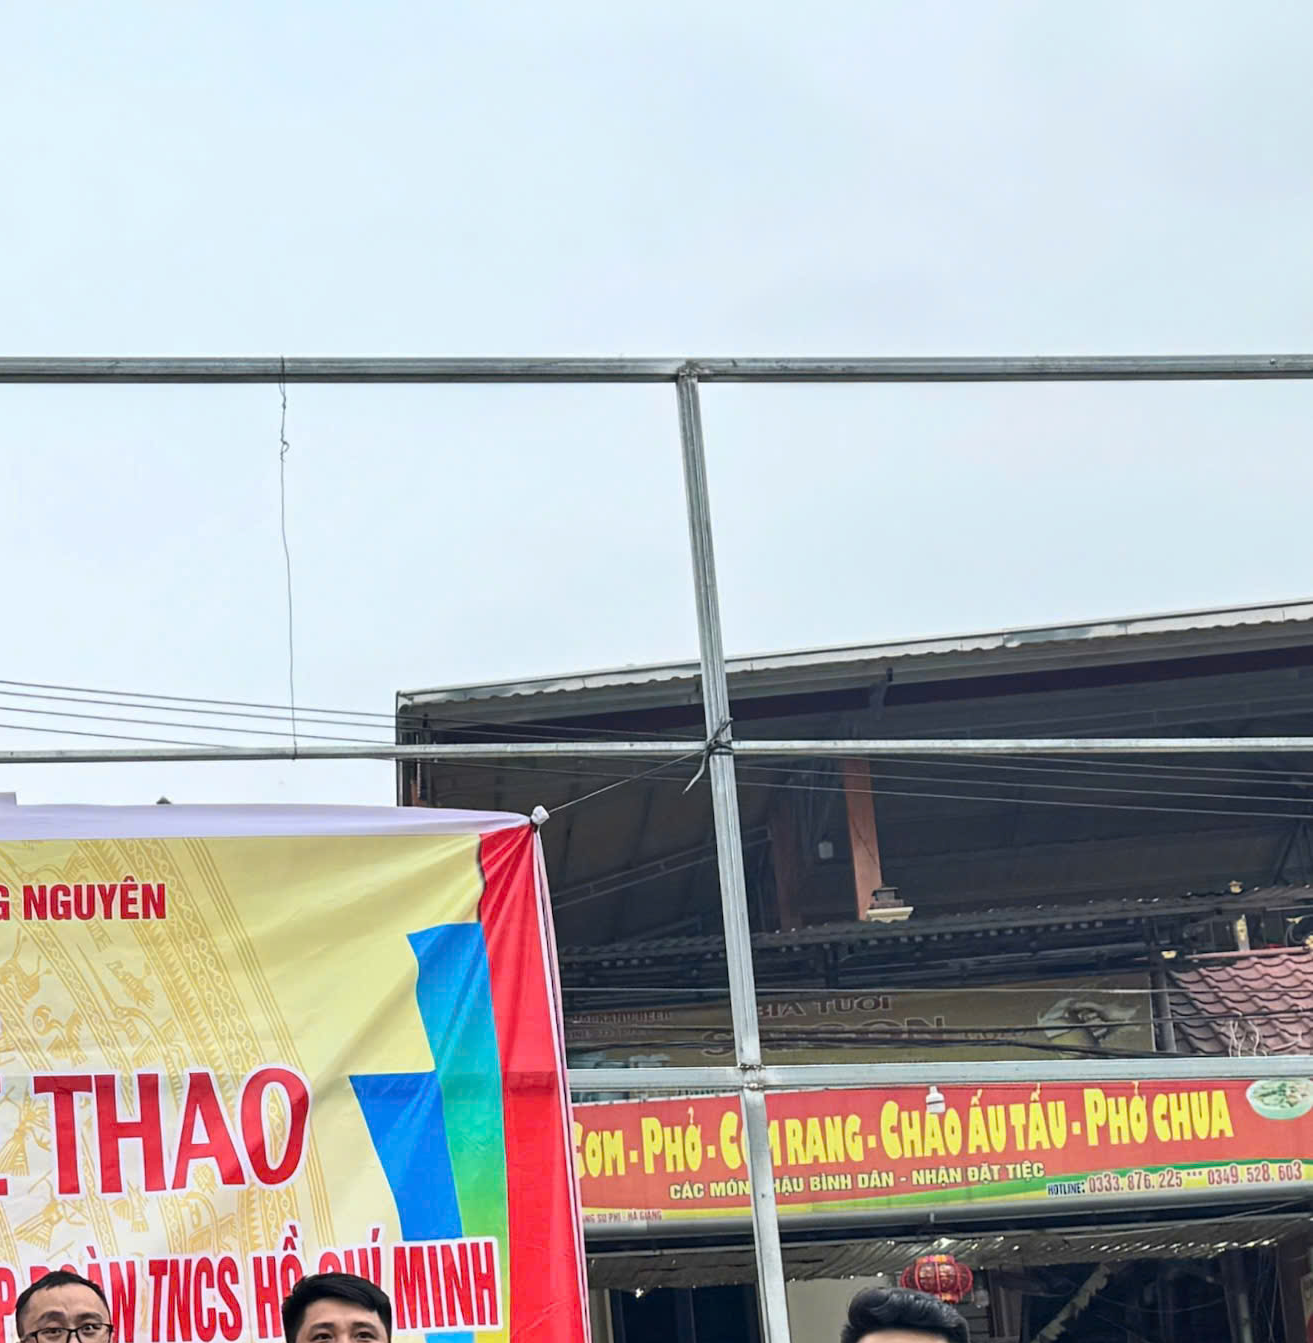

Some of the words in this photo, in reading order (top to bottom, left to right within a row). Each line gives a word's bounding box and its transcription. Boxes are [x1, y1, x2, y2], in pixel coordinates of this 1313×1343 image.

[23, 875, 166, 920] NGUYÊN
[33, 1068, 310, 1195] THAO
[785, 1114, 864, 1165] RANG
[1152, 1090, 1234, 1142] CHUA
[669, 1181, 704, 1200] CÁC
[710, 1179, 750, 1198] MÓN
[809, 1171, 852, 1192] BÌNH
[857, 1169, 894, 1189] DÂN
[912, 1165, 963, 1187] NHẬN
[1006, 1161, 1045, 1181] TIỆC
[149, 1256, 242, 1343] TNCS
[394, 1241, 498, 1330] MINH
